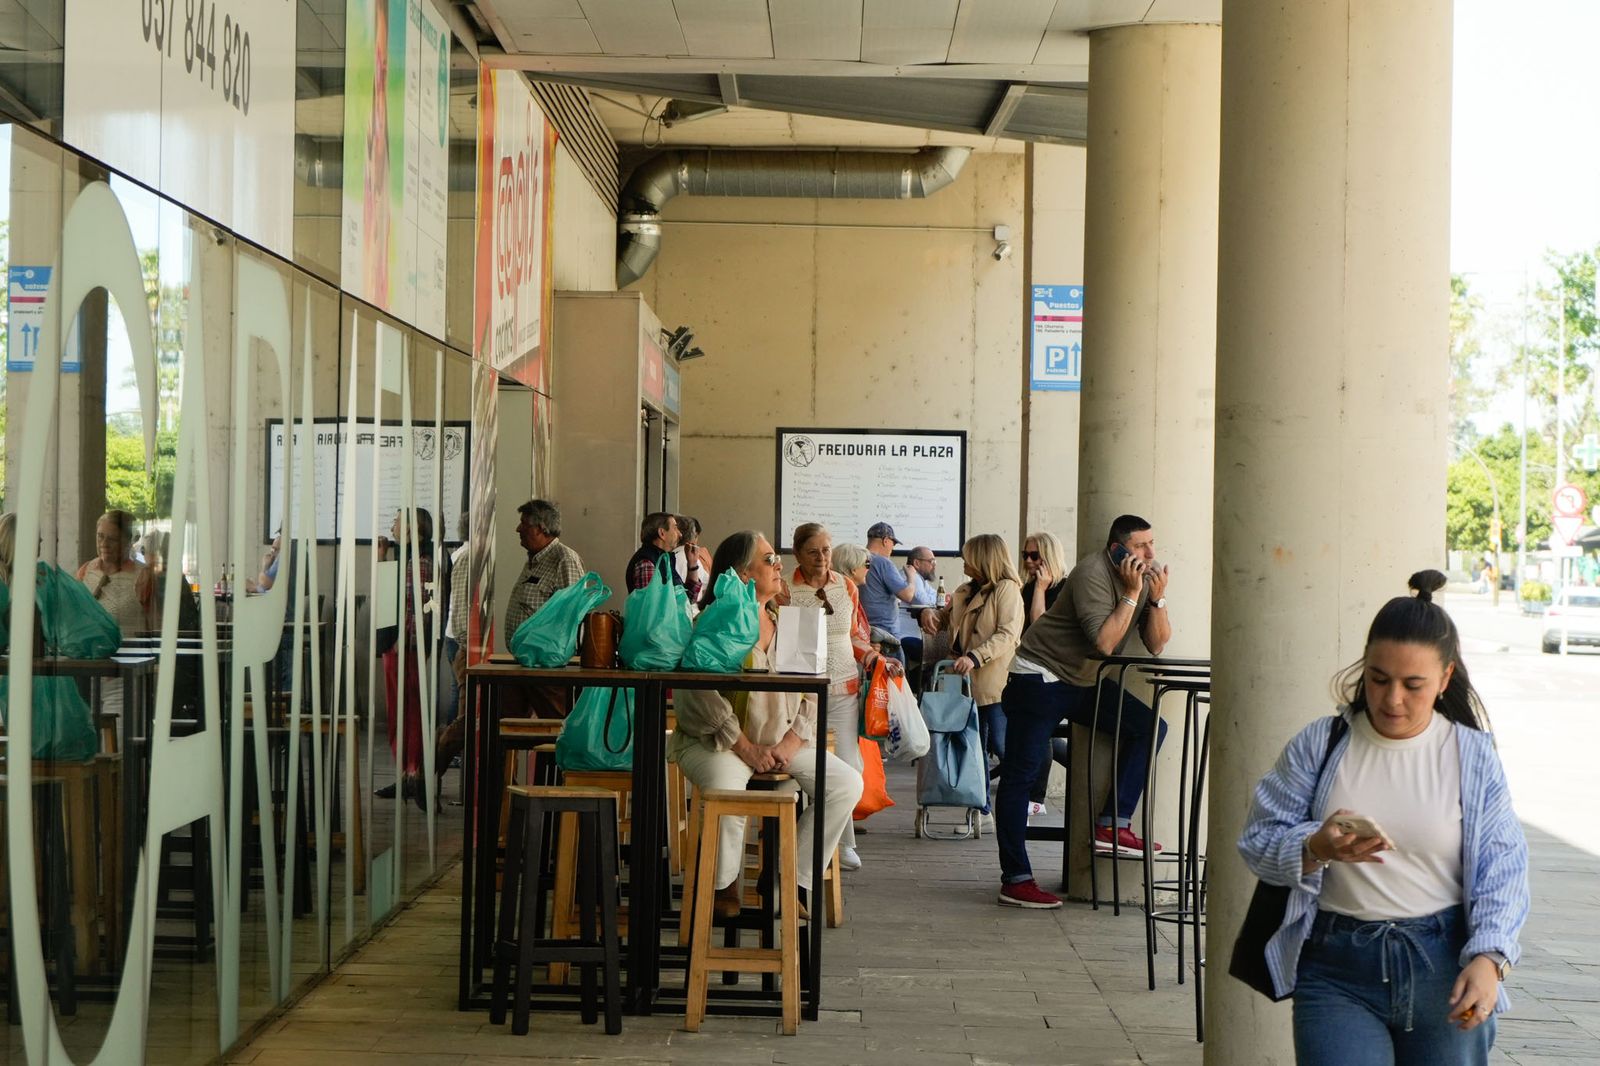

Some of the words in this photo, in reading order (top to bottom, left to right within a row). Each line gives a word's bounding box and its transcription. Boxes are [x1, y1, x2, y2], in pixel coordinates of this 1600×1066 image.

[185, 0, 216, 90] 844
[223, 13, 250, 116] 820
[1049, 348, 1065, 368] P
[818, 443, 886, 456] FREIDURIA
[891, 444, 907, 457] LA
[913, 445, 954, 458] PLAZA
[7, 180, 443, 1066] CARMEN
